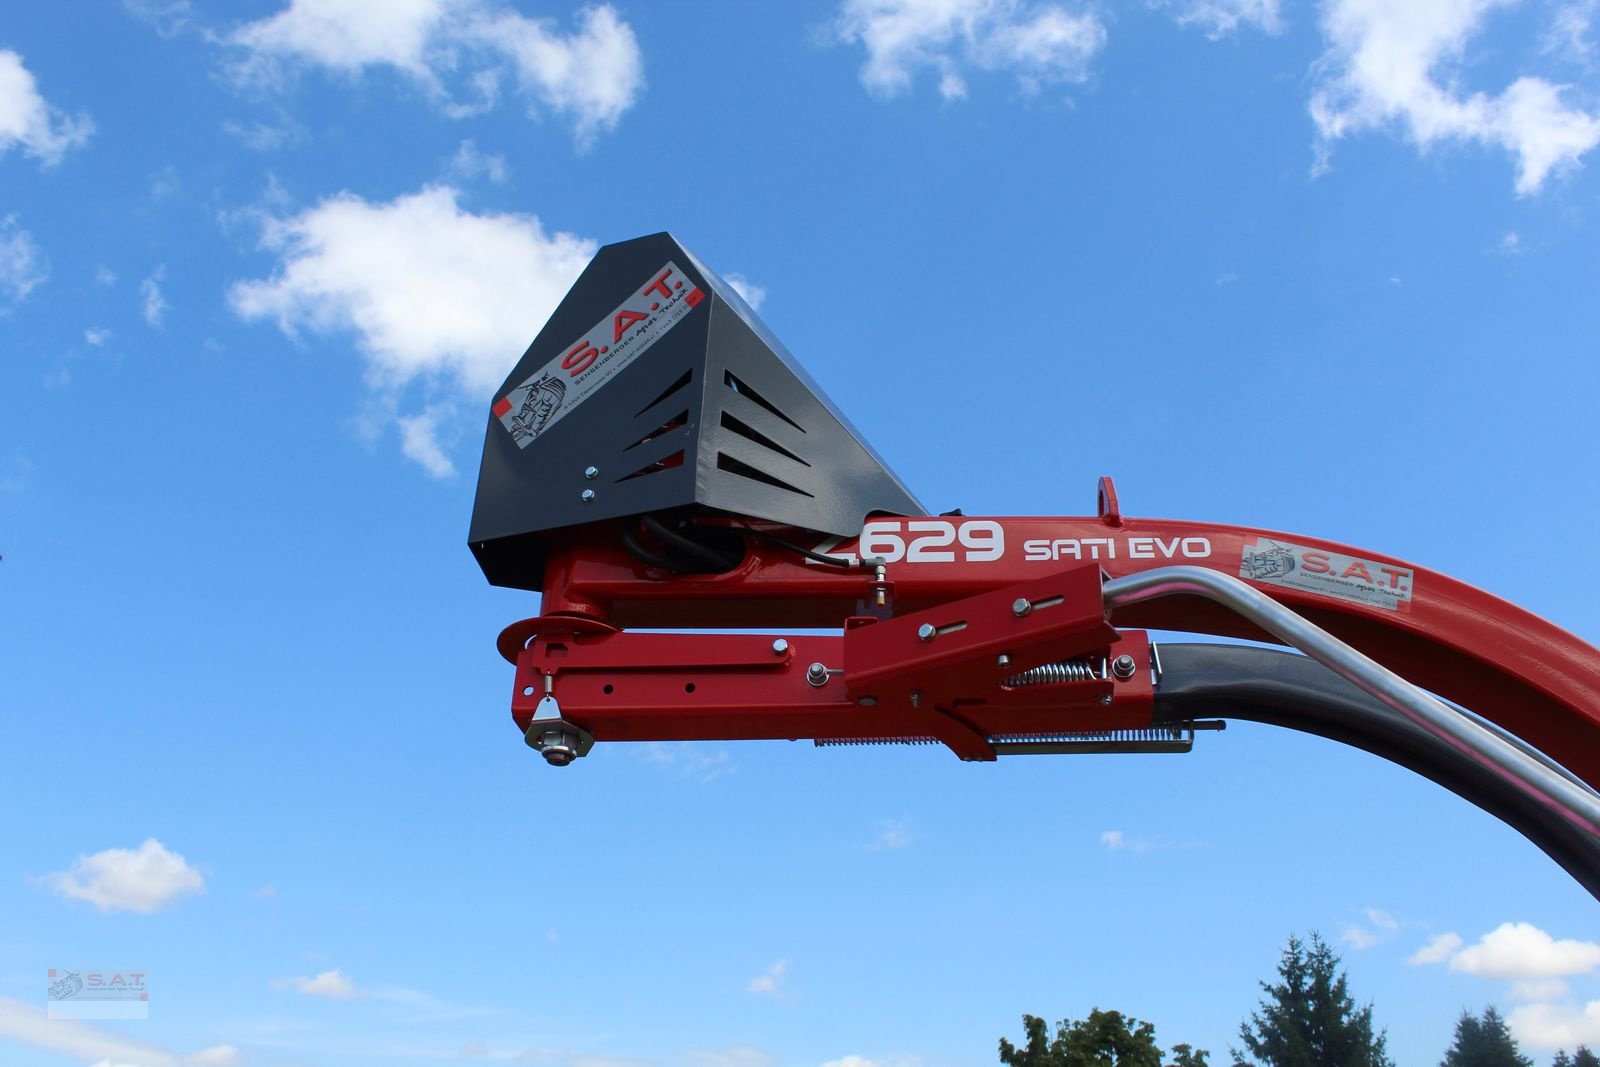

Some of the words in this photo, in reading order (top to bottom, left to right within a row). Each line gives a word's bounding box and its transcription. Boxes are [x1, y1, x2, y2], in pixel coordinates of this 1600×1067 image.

[560, 268, 683, 378] S.A.T.
[574, 336, 634, 386] SENSENBERGER
[636, 317, 658, 336] Agrar
[659, 288, 688, 313] Technik
[1024, 538, 1115, 561] SATI
[1129, 537, 1211, 558] EVO
[1301, 552, 1409, 592] S.A.T.
